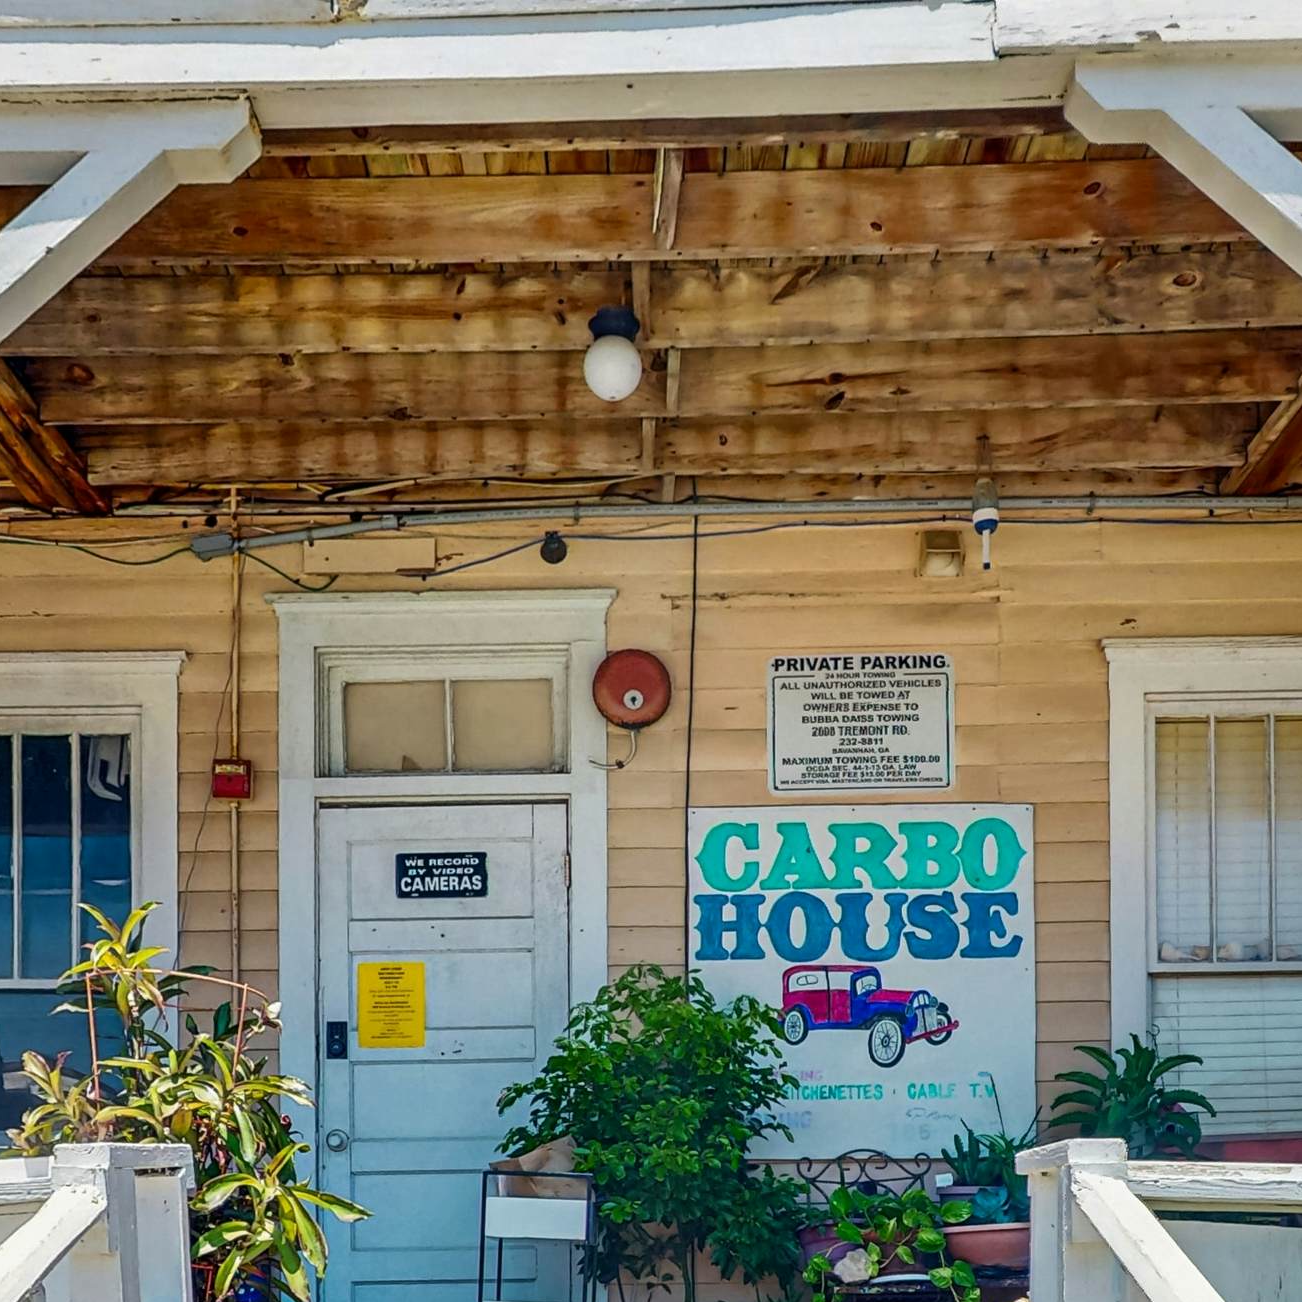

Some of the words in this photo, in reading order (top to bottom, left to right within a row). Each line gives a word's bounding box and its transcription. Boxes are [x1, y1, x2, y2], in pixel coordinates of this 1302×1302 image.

[774, 657, 853, 671] PRIVATE
[861, 656, 945, 669] PARKING
[780, 682, 800, 690] ALL
[803, 680, 886, 689] UNAUTHORIZED
[890, 679, 941, 687] VEHICLES
[811, 692, 836, 700] WILL
[840, 692, 853, 700] BE
[857, 691, 895, 699] TOWED
[897, 691, 910, 699] AT
[803, 703, 849, 713] OWNERS
[853, 703, 900, 712] EXPENSE
[904, 703, 918, 711] TO
[802, 715, 839, 724] BUBBA
[876, 714, 919, 722] TOWING
[838, 726, 889, 736] TREMONT
[782, 757, 832, 765] MAXIMUM
[835, 756, 877, 765] TOWING
[880, 756, 899, 764] FEE
[902, 755, 940, 763] $100.00
[695, 818, 1027, 892] CARBO
[405, 859, 424, 867] WE
[429, 858, 479, 866] RECORD
[408, 868, 426, 876] BY
[432, 867, 474, 875] VIDEO
[401, 875, 482, 892] CAMERAS
[694, 891, 1023, 962] HOUSE
[907, 1083, 956, 1099] CABLE
